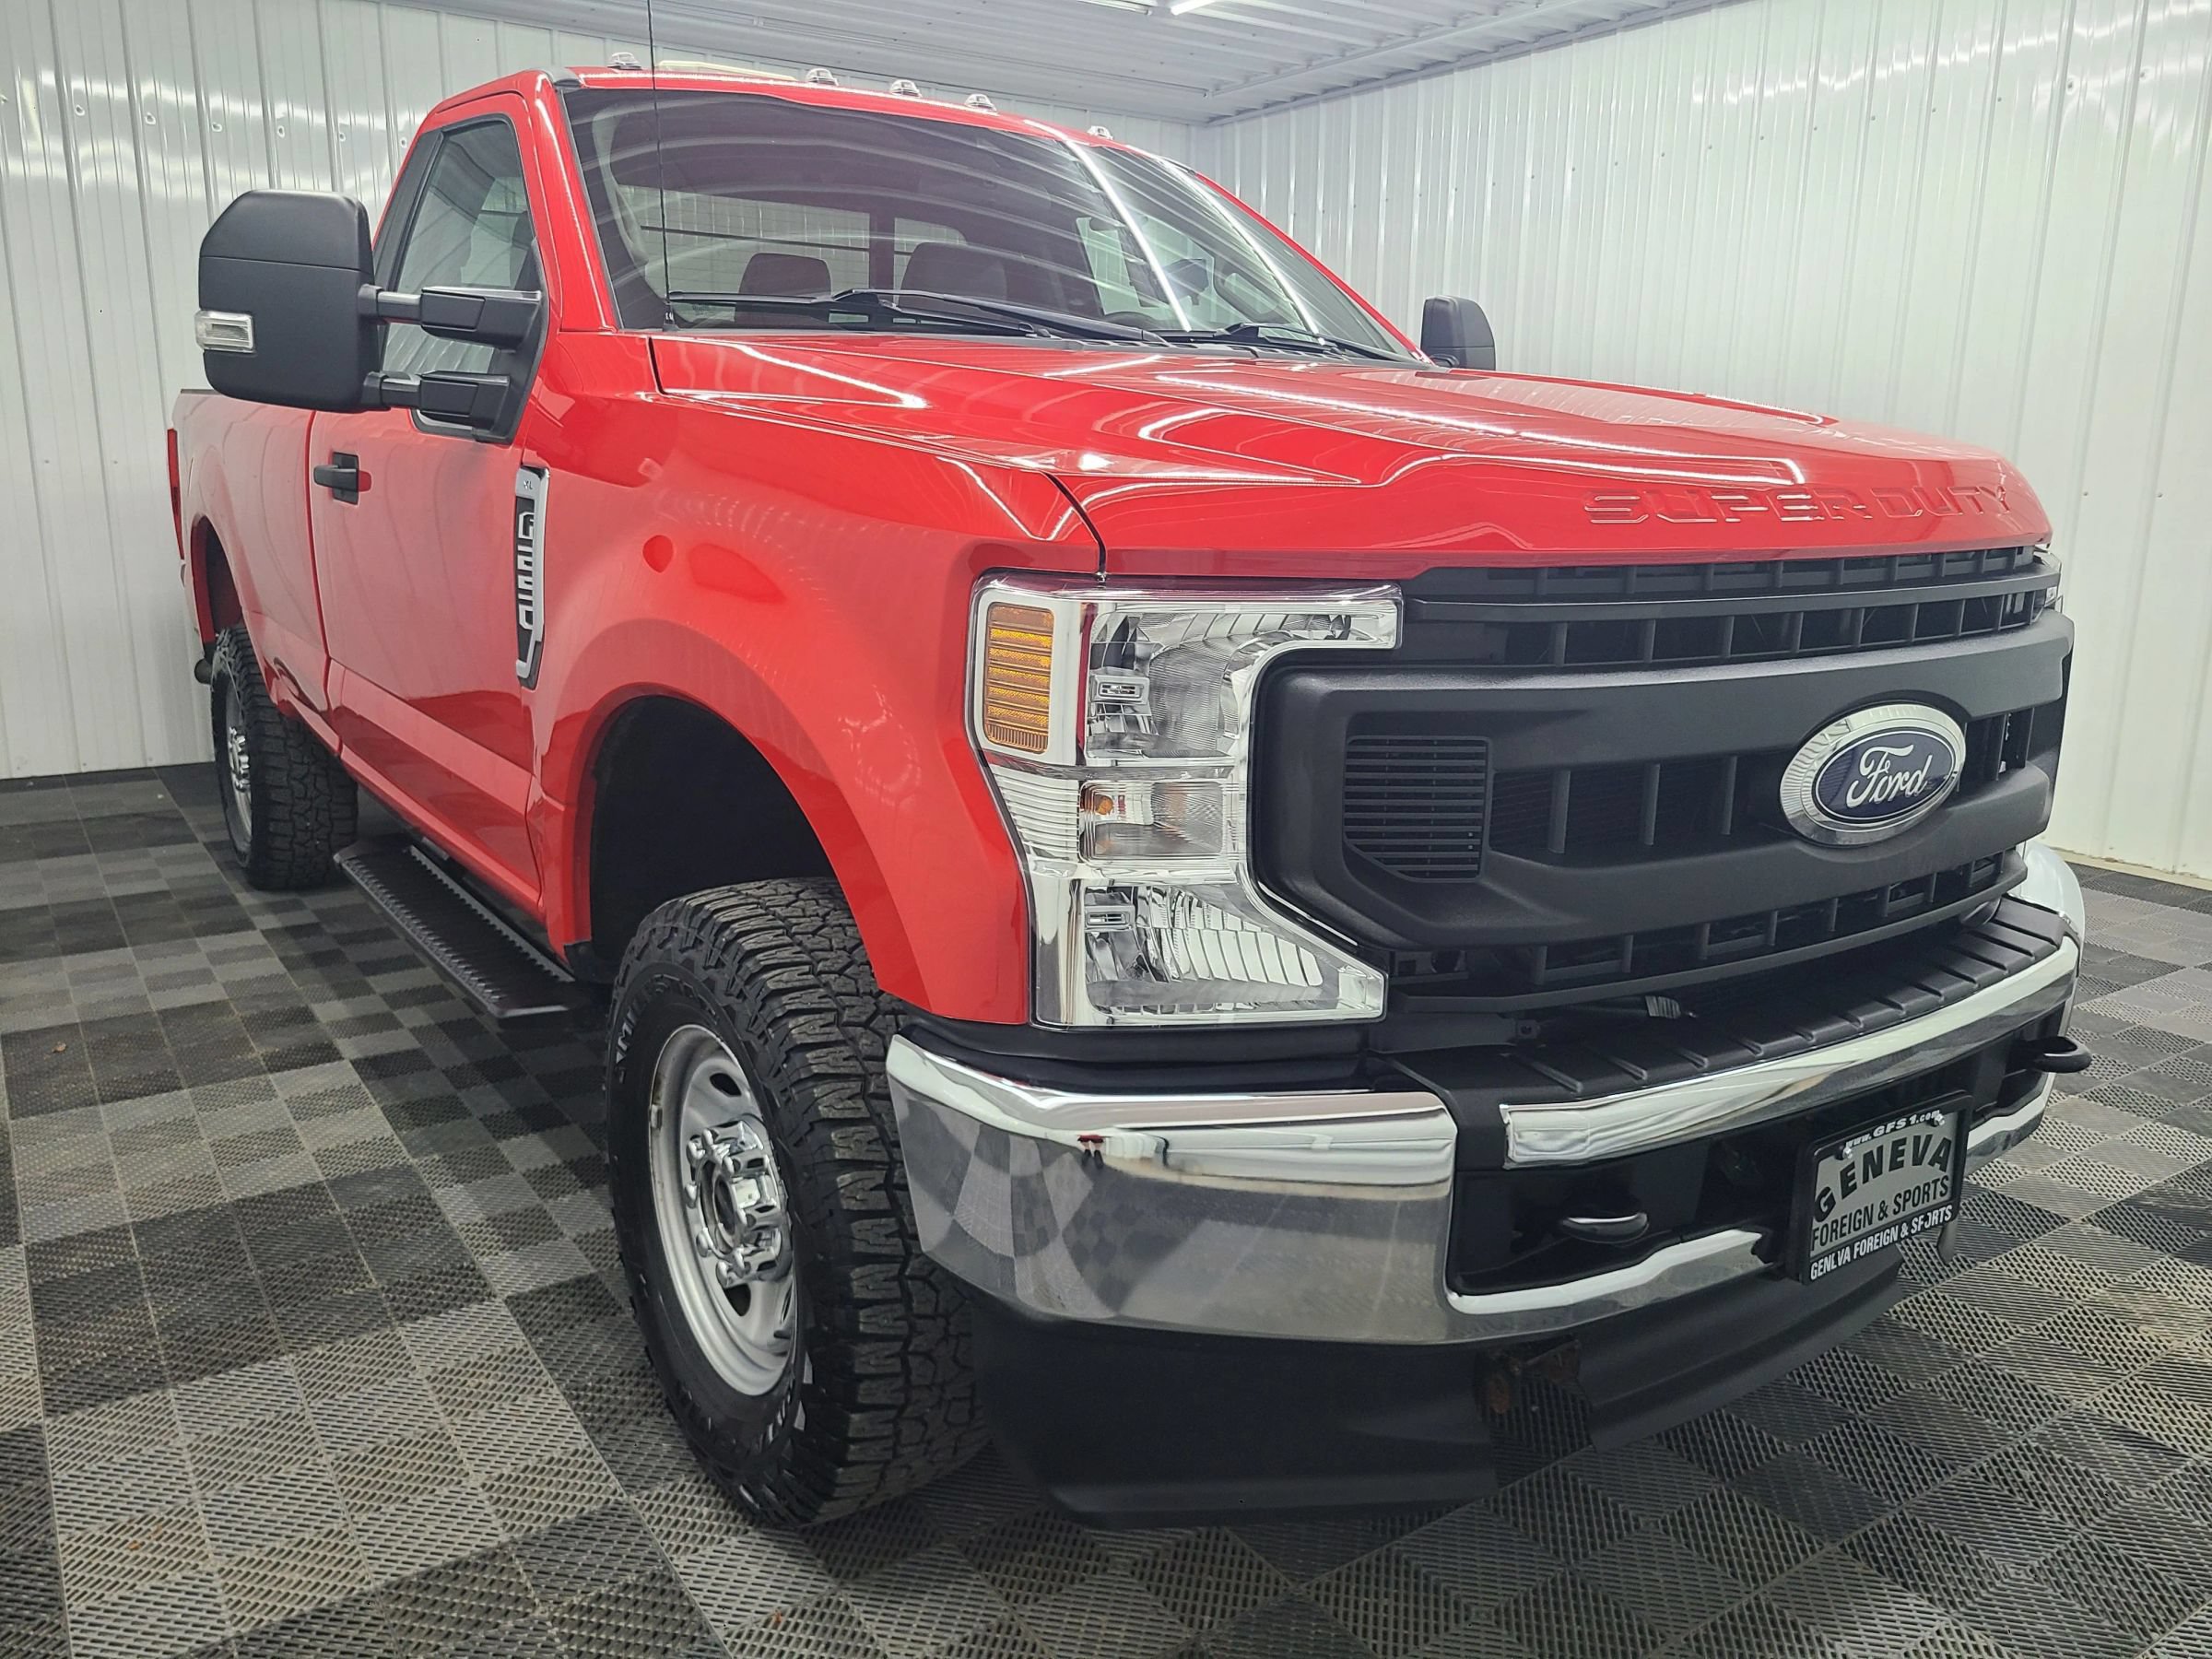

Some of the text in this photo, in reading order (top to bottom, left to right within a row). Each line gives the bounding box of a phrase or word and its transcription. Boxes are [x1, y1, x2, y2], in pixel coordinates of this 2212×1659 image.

[1584, 485, 2009, 524] SUPER DUTY
[1845, 744, 1933, 808] Ford
[1814, 1134, 1952, 1222] GENEVA
[1812, 1175, 1949, 1251] FOREIGN & SPORTS
[1853, 1225, 1899, 1259] FOREIGN
[1900, 1222, 1909, 1238] &
